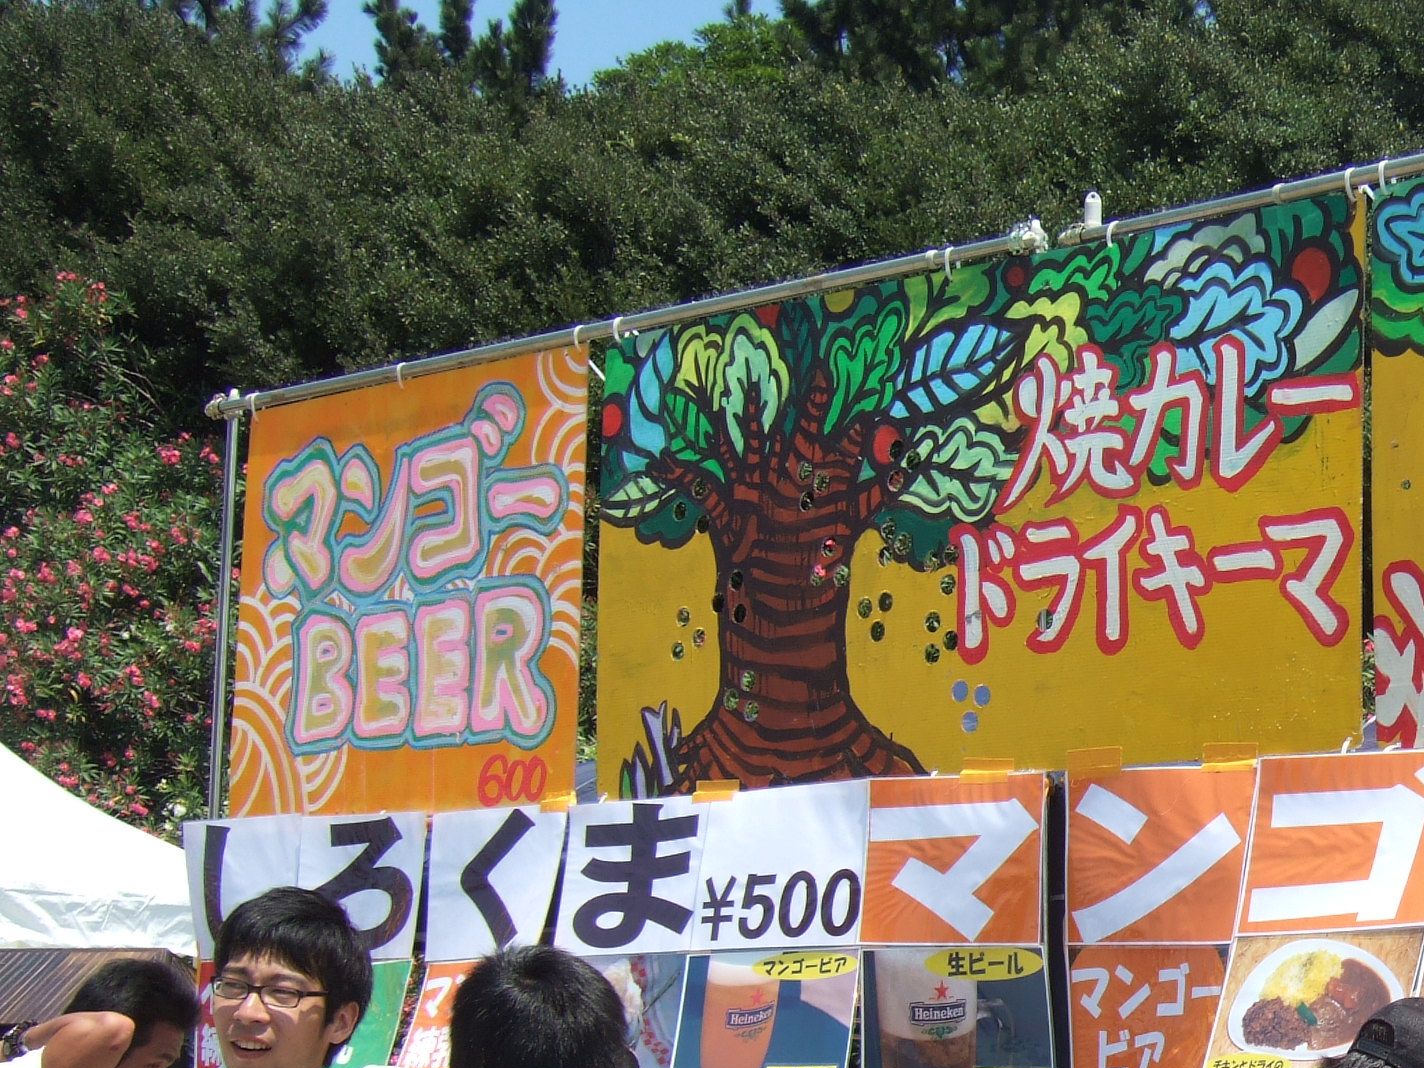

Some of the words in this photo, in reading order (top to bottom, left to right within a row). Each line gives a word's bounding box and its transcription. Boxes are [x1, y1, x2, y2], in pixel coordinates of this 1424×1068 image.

[1000, 337, 1357, 510] 焼カレー
[266, 384, 566, 598] マンゴー
[958, 506, 1350, 660] ドライキーマ
[287, 578, 553, 752] BEER
[477, 754, 548, 807] 600
[701, 868, 861, 942] ¥500
[763, 956, 848, 976] マンゴービア
[947, 952, 1024, 977] 生ビール
[1071, 961, 1222, 1020] マンゴー
[730, 1006, 774, 1025] Heineken
[913, 1005, 964, 1022] Heineken
